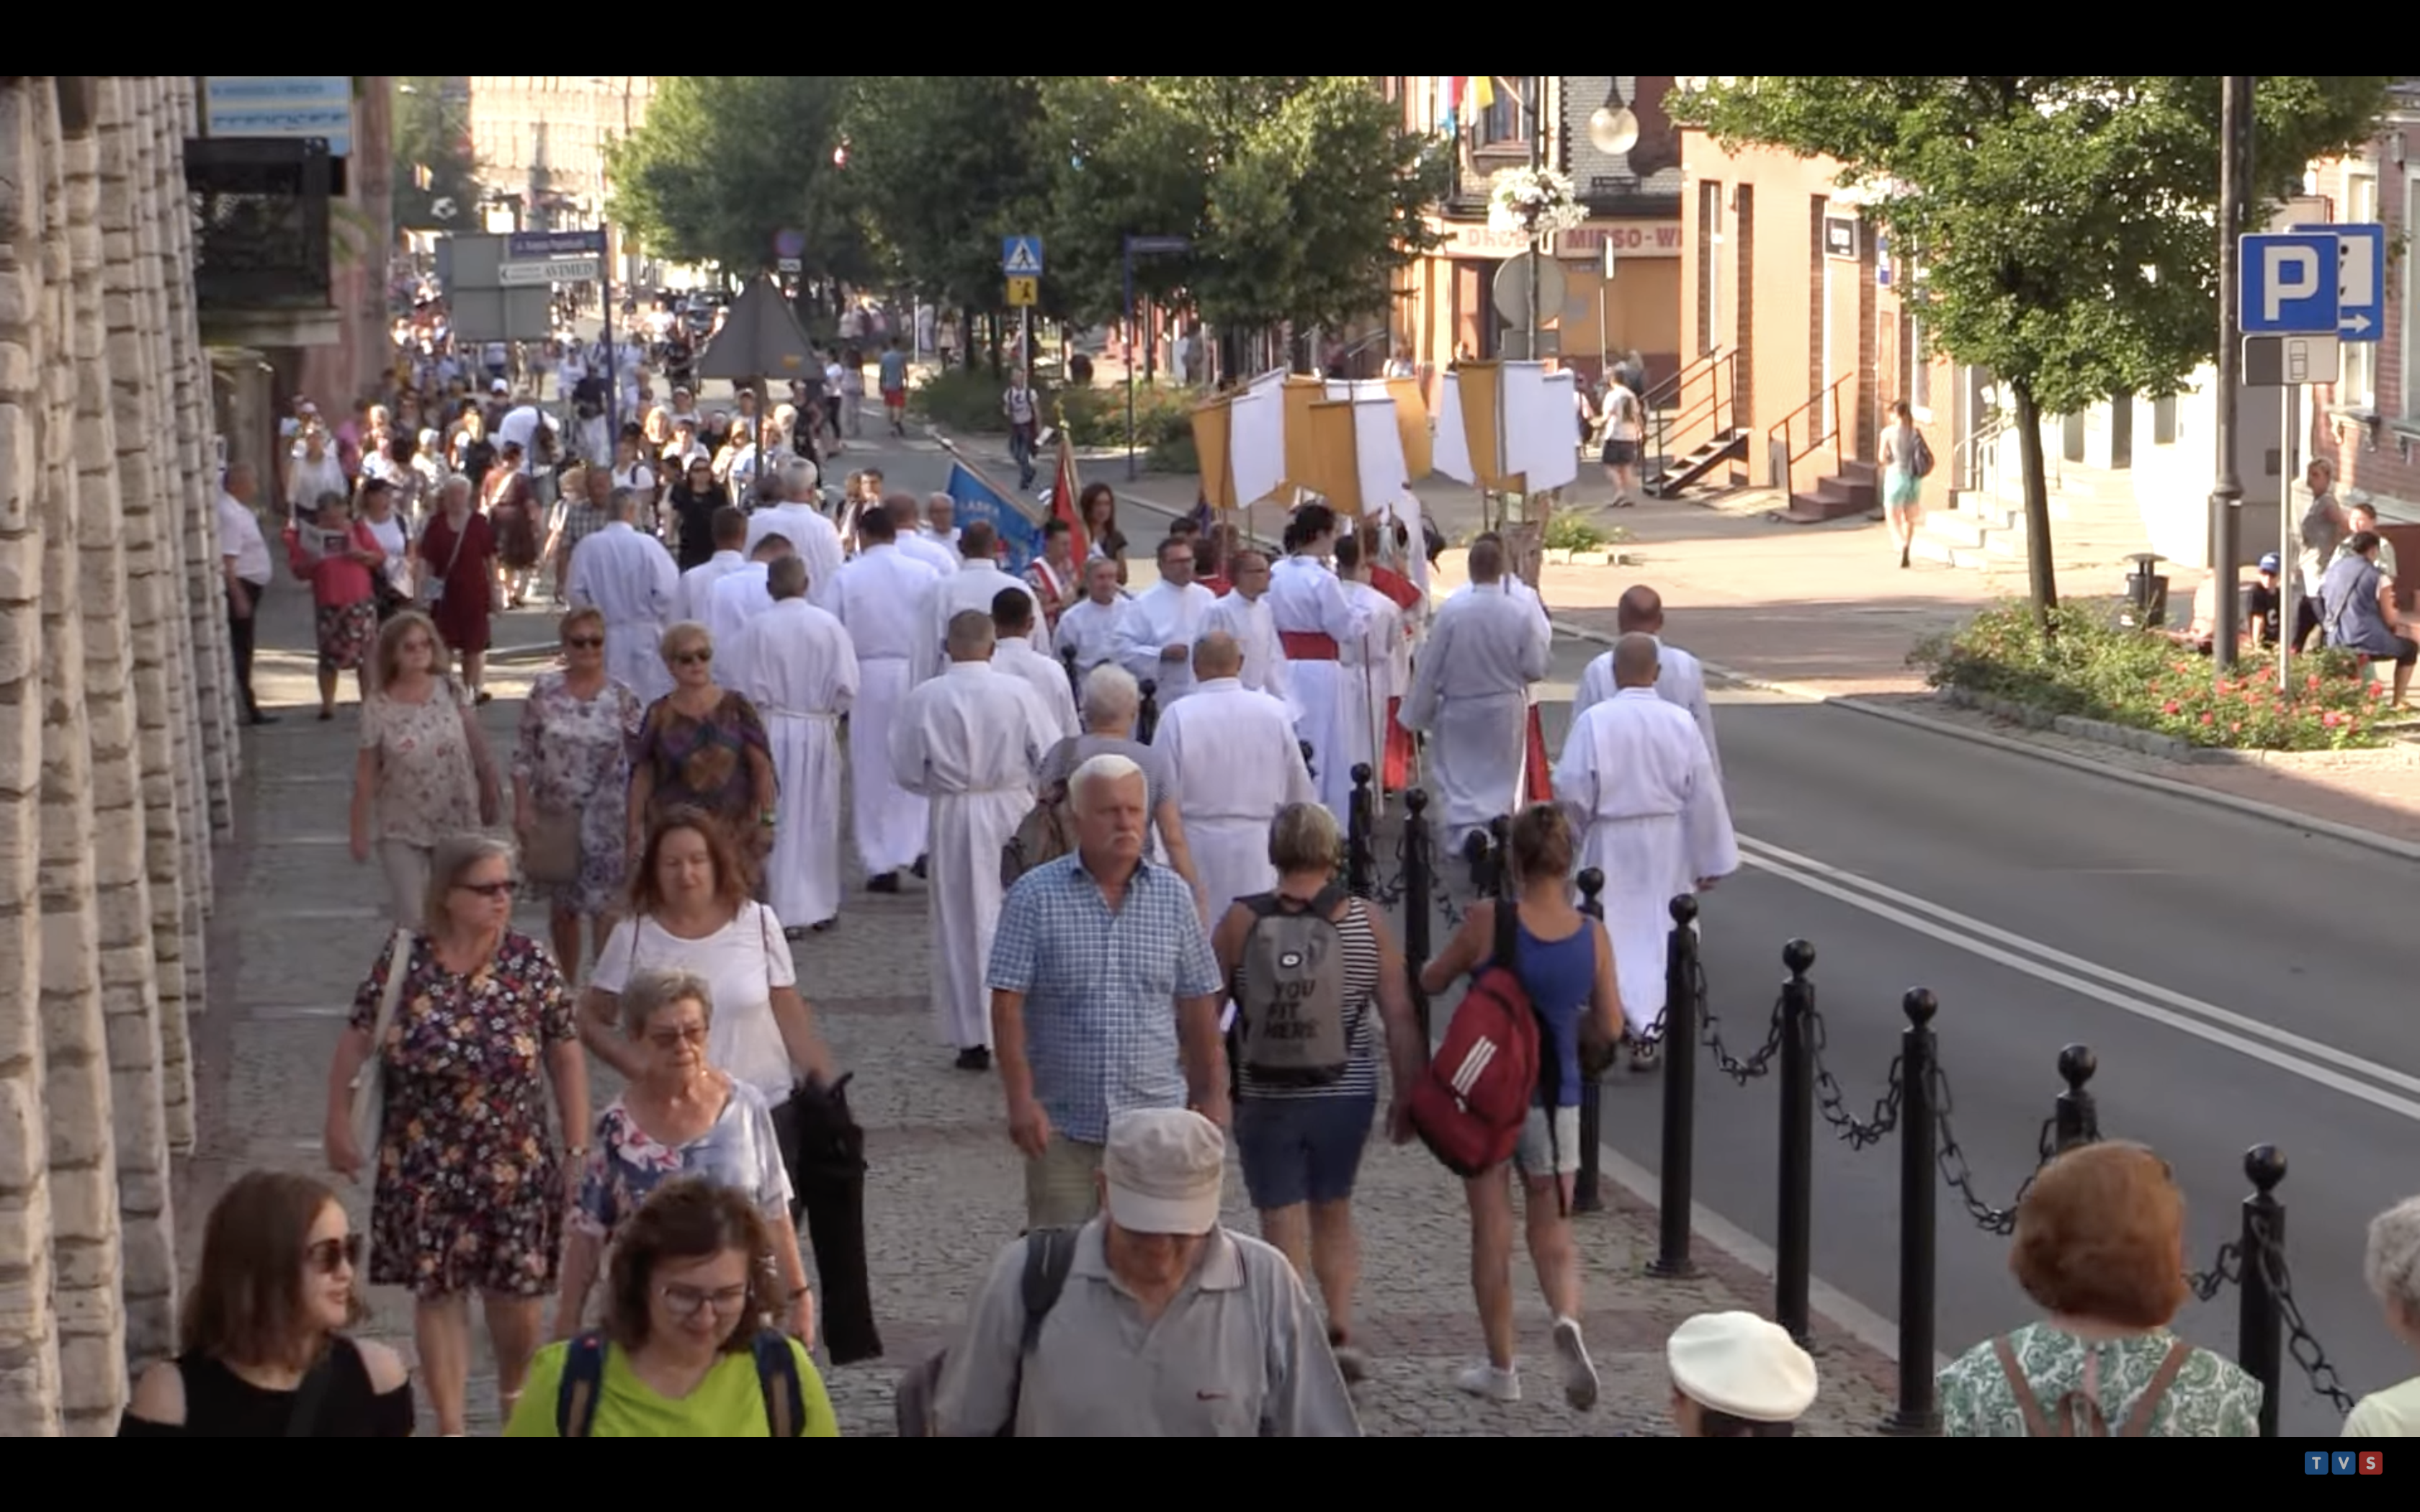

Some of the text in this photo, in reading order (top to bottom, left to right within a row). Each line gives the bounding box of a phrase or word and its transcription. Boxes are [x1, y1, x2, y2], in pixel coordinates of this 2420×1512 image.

[2264, 246, 2318, 321] P
[1274, 980, 1316, 999] YOU
[1266, 1001, 1301, 1018] FIT
